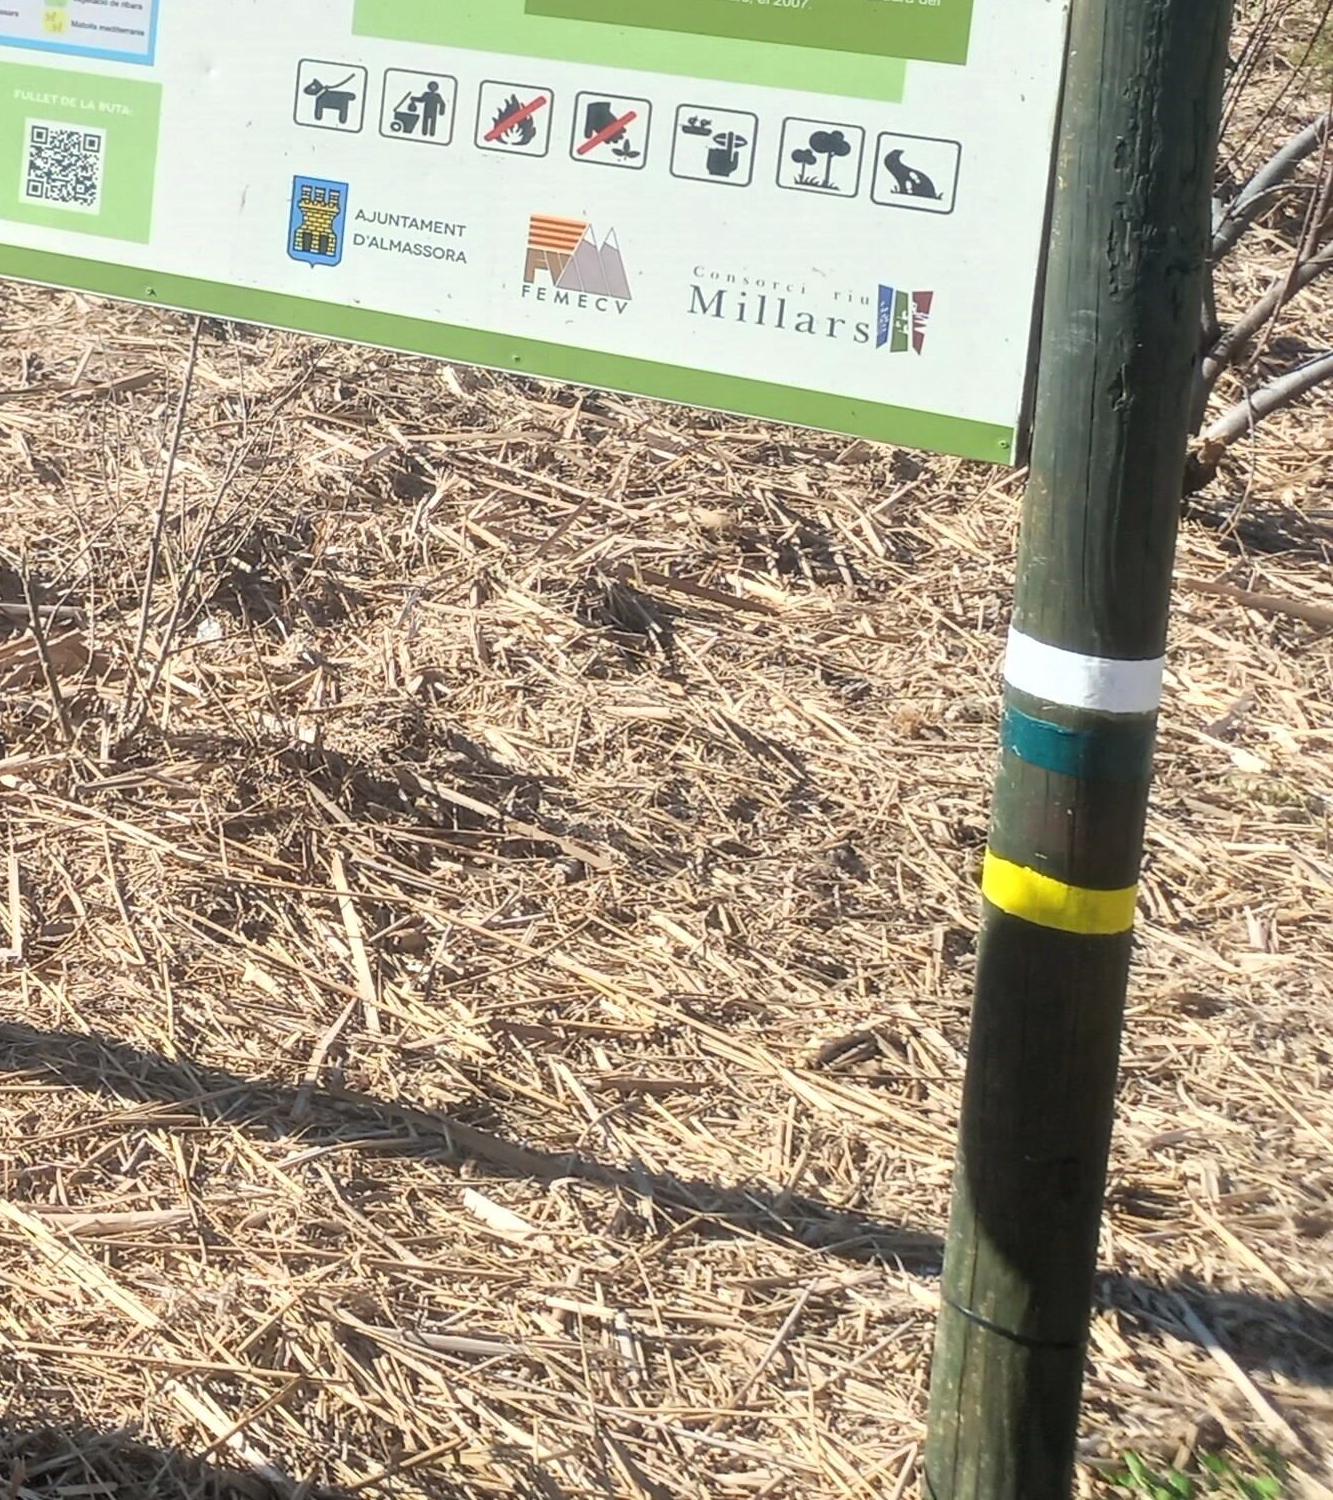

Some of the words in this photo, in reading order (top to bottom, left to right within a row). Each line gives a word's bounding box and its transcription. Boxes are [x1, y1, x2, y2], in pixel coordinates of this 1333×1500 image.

[13, 89, 59, 104] FULLET
[60, 96, 77, 108] DE
[80, 100, 95, 110] LA
[356, 209, 467, 236] AJUNTAMENT
[353, 233, 467, 265] D'ALMASSORA
[522, 285, 628, 314] FEMECV
[693, 265, 806, 295] Consorci
[834, 290, 870, 306] riu
[687, 284, 870, 344] Millars
